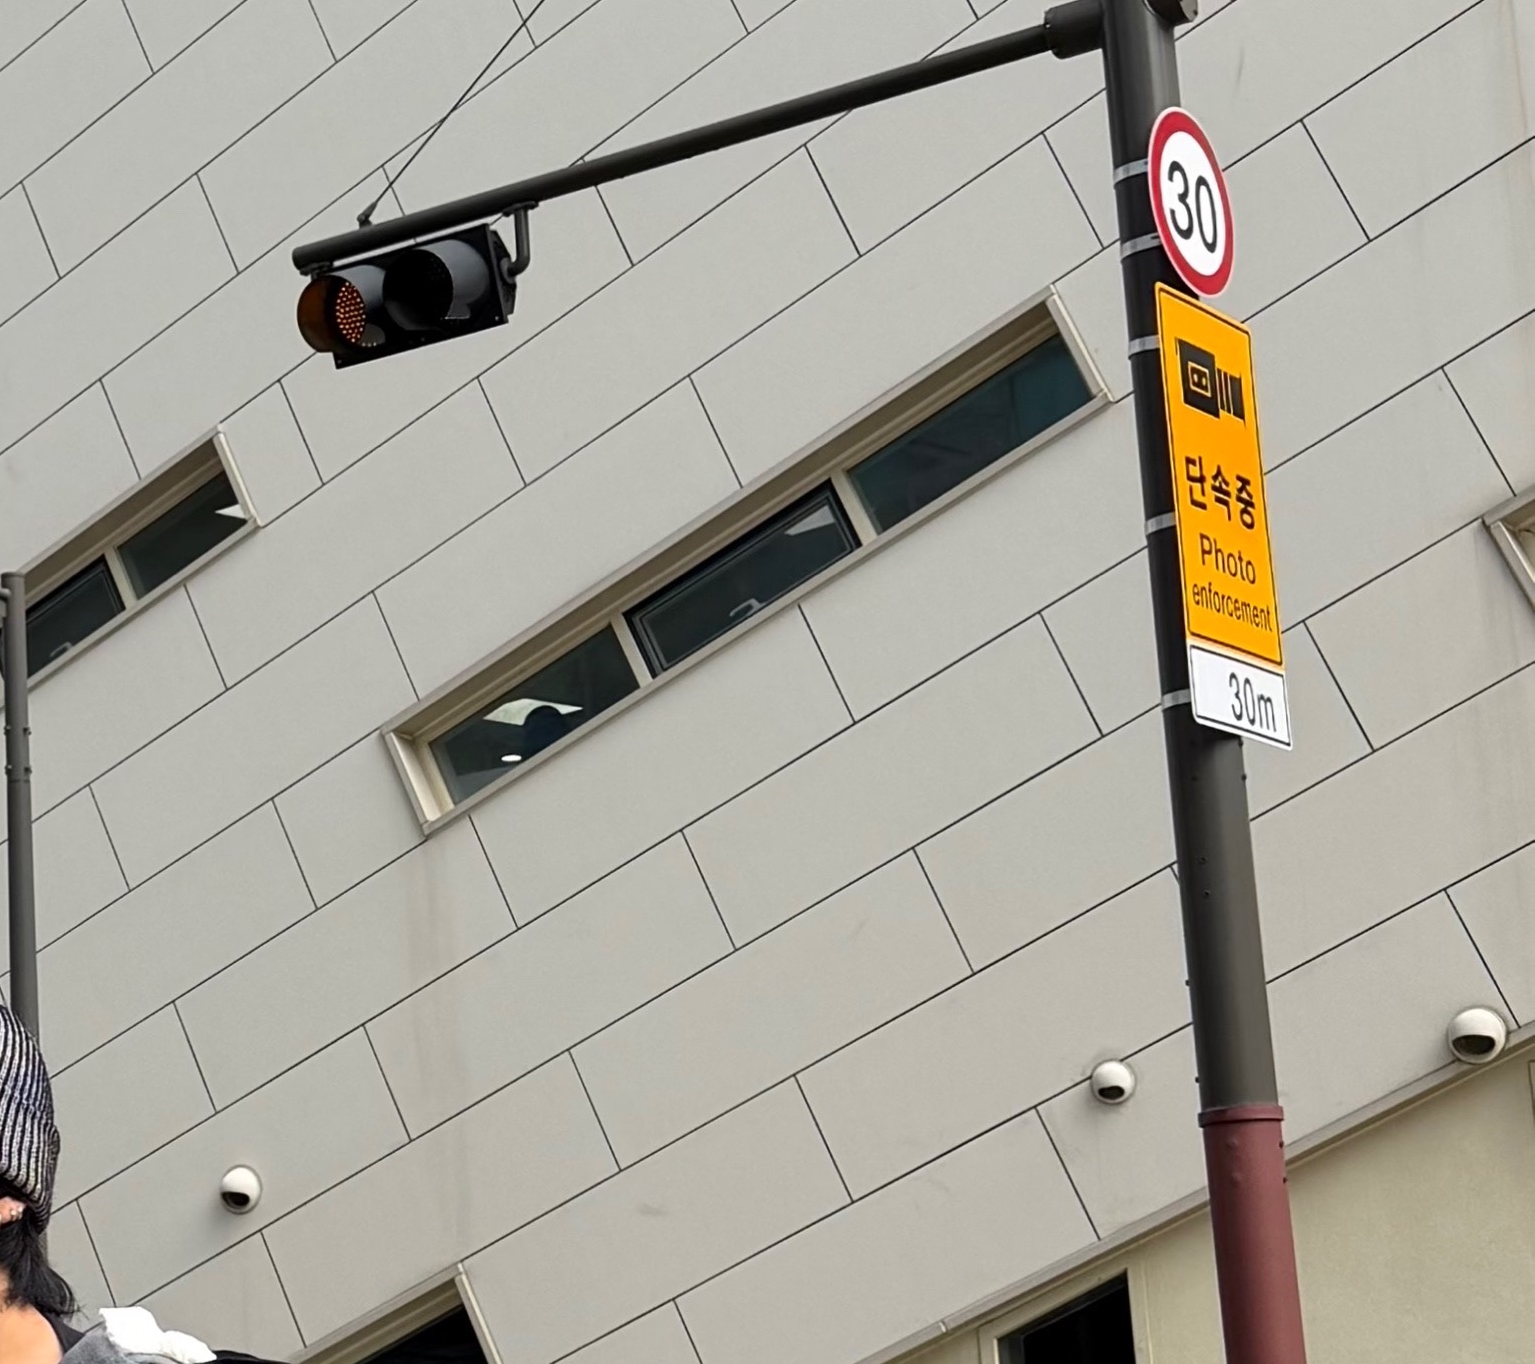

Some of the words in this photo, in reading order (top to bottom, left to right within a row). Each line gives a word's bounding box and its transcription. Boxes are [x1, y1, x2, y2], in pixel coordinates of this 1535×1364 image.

[1168, 160, 1217, 254] 30
[1185, 456, 1255, 530] 단속중
[1199, 532, 1256, 585] Photo
[1192, 581, 1272, 633] enforcement
[1229, 672, 1277, 733] 30m
